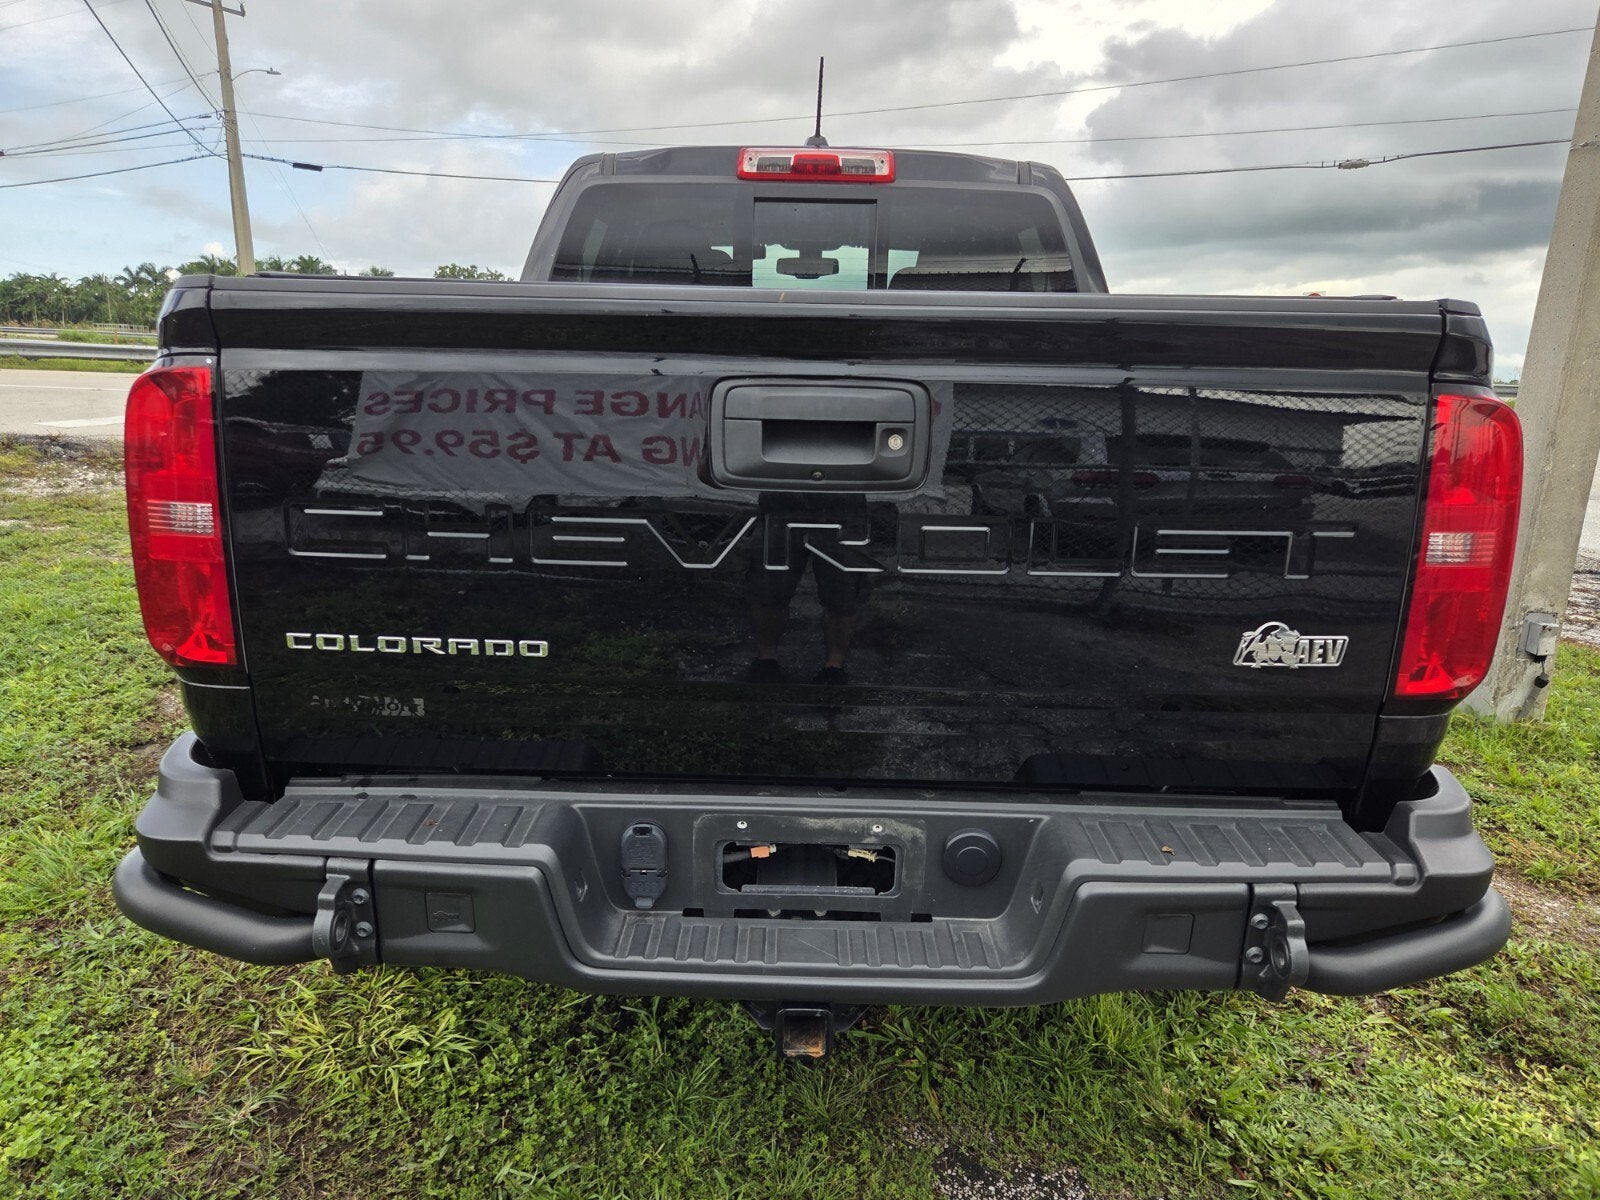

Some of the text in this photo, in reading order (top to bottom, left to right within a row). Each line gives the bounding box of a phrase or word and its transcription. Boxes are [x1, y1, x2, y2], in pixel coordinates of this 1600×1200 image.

[287, 503, 1357, 580] CHEVROLET
[286, 632, 549, 658] COLORADO
[1295, 639, 1344, 665] AEV
